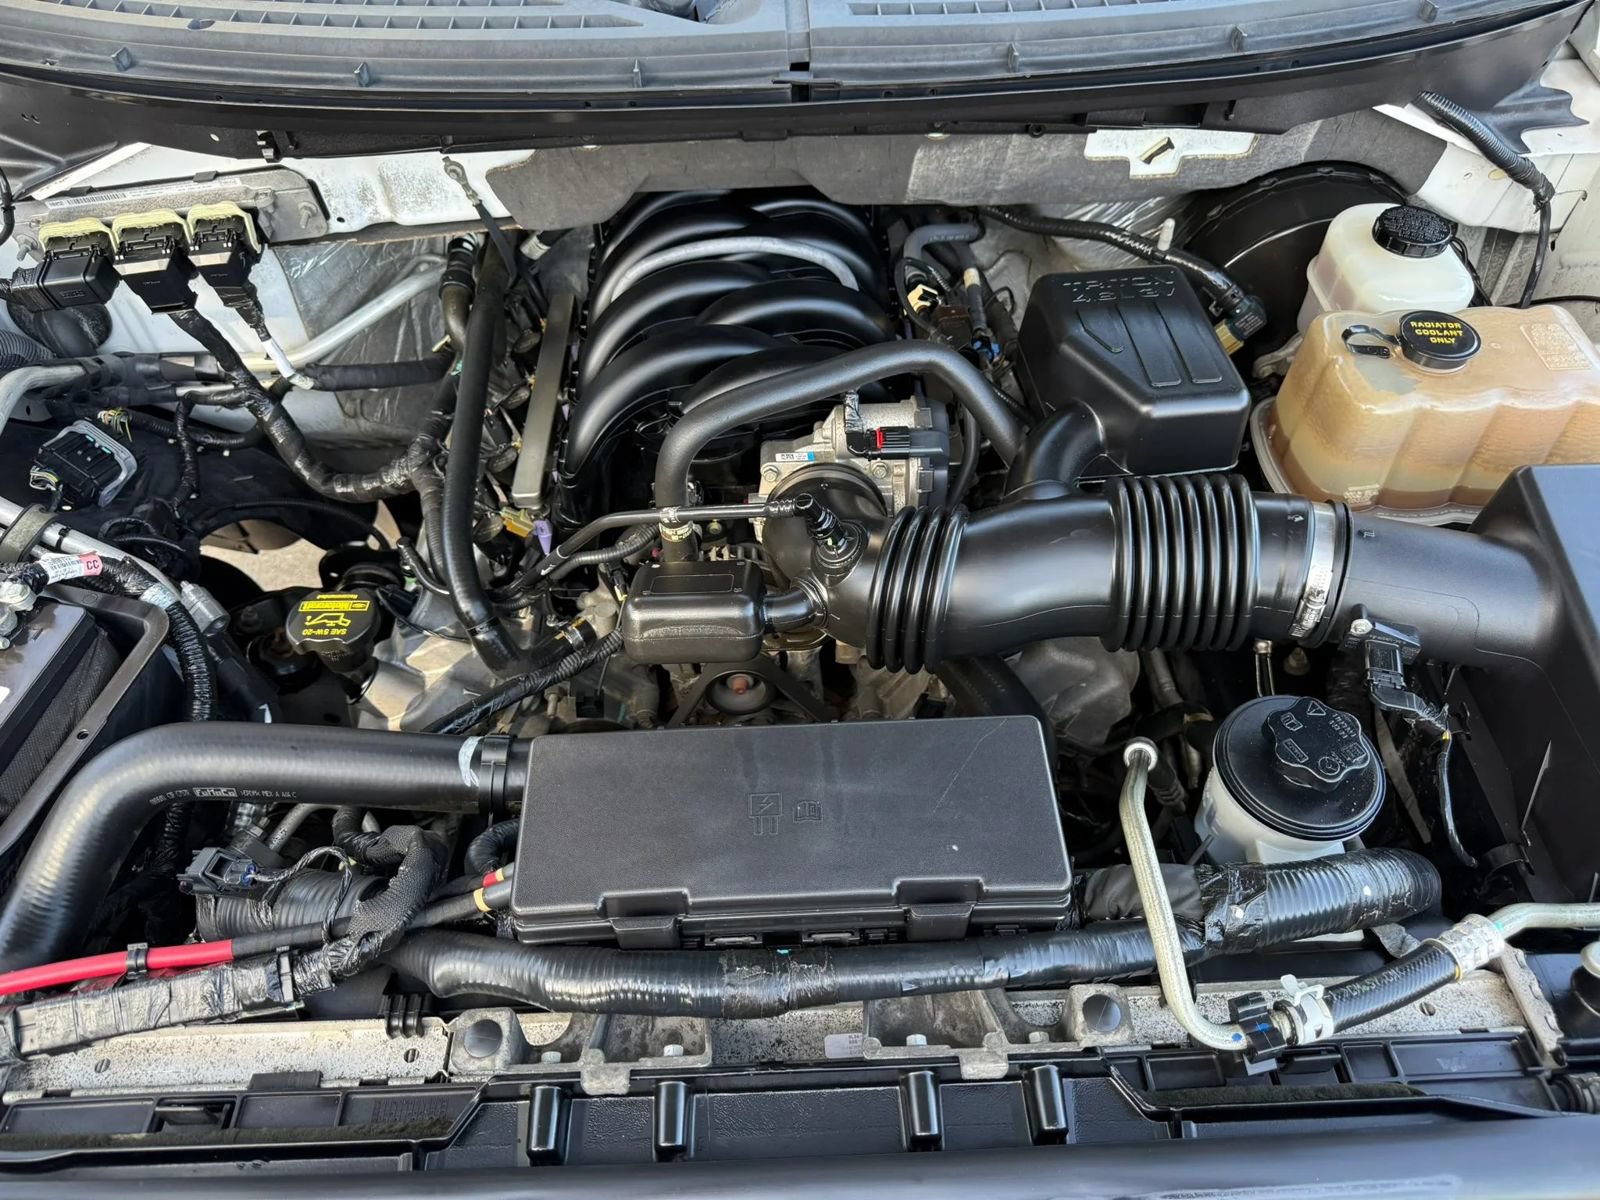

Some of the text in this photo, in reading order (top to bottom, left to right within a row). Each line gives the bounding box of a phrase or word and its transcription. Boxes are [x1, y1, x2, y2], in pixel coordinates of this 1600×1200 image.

[1410, 321, 1461, 329] RADIATOR
[1415, 329, 1463, 337] COOLANT
[86, 560, 100, 570] CC
[302, 628, 330, 636] 5W-20
[194, 788, 237, 797] FoMoCo
